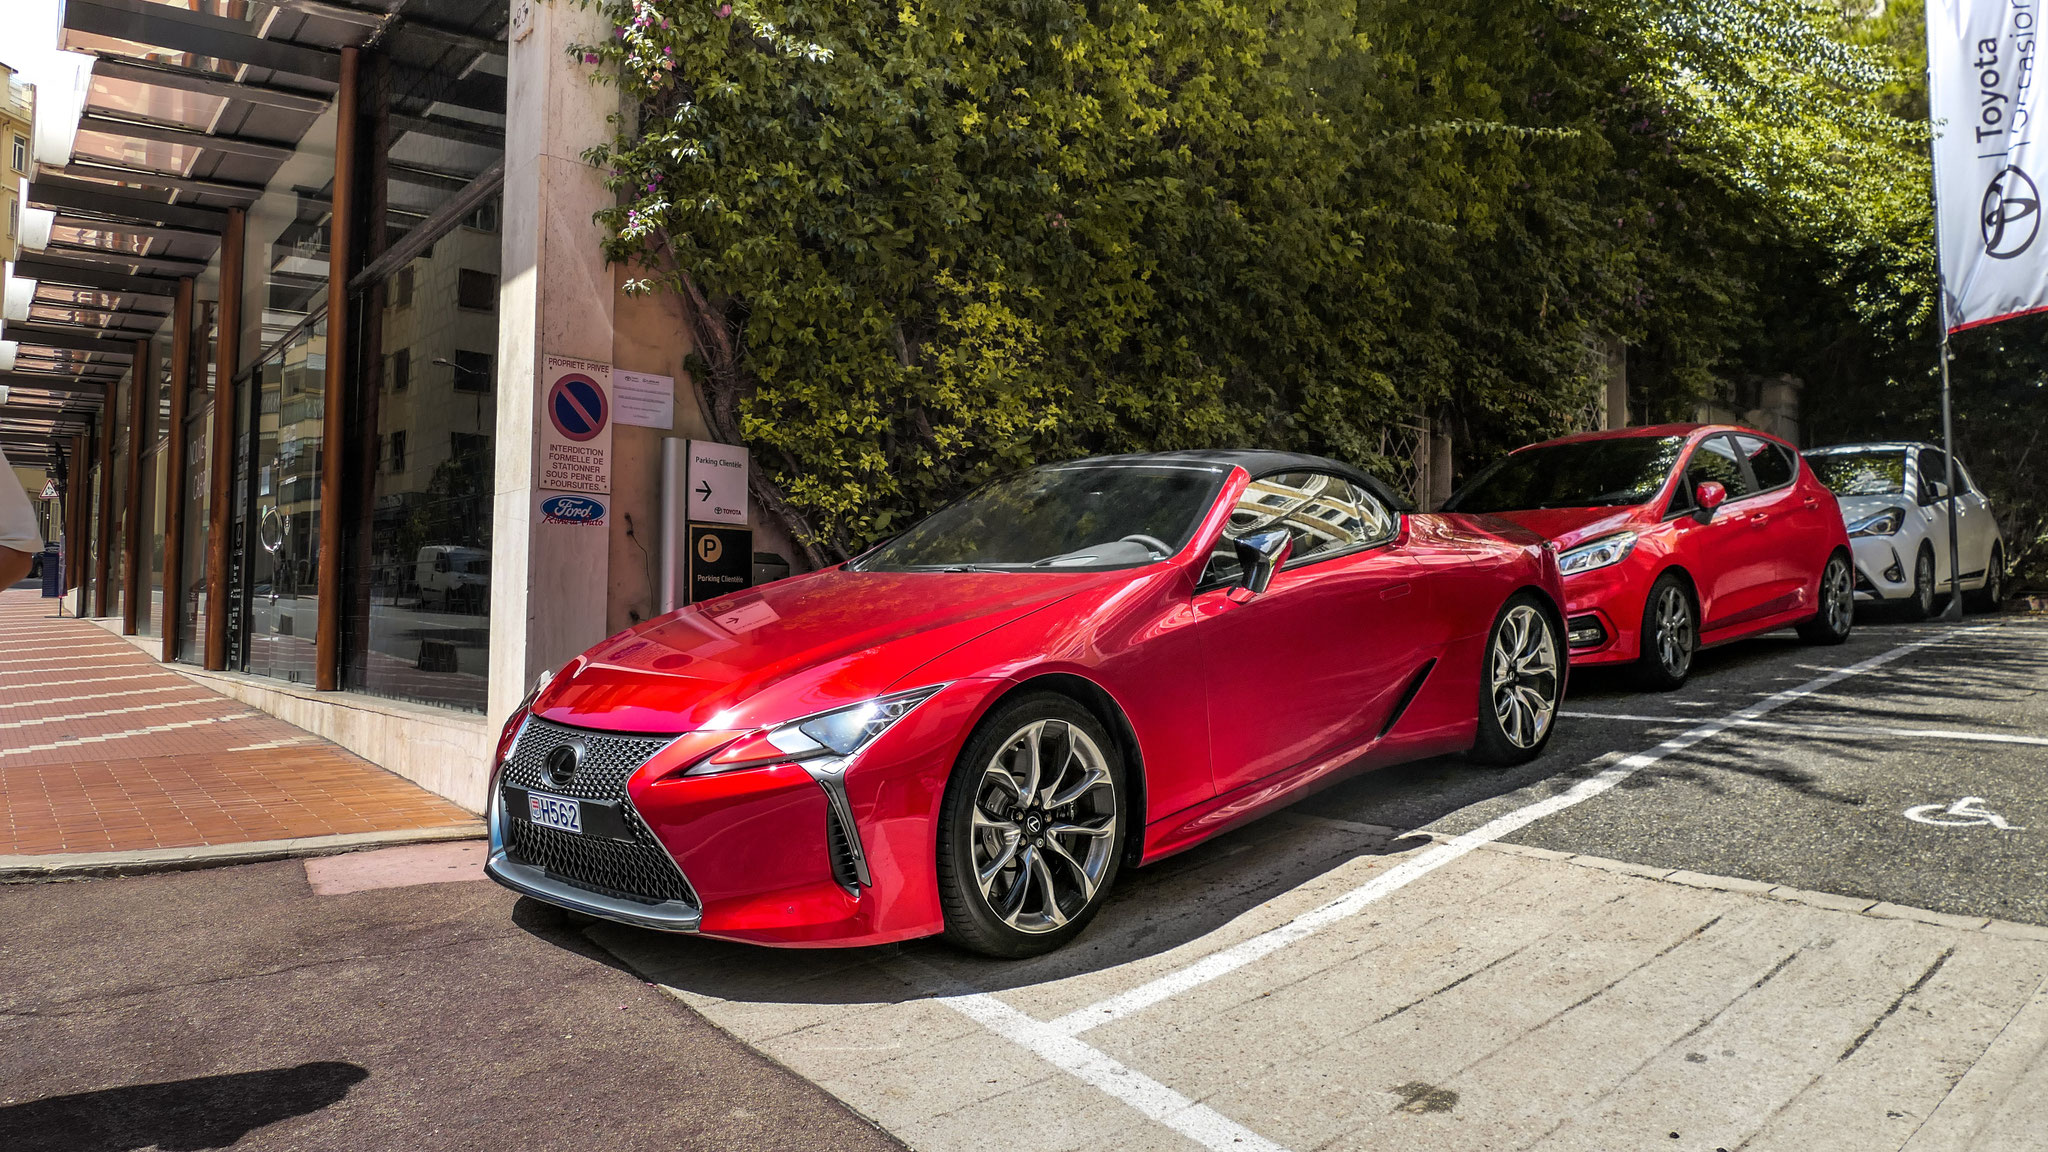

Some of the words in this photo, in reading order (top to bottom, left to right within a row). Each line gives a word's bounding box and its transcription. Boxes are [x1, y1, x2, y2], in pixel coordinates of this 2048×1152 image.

[1974, 38, 2008, 144] Toyota
[548, 357, 585, 370] PROPRIETE
[586, 363, 610, 374] PRIVEE
[549, 443, 604, 457] INTERDICTION
[548, 452, 591, 464] FORMELLE
[593, 457, 604, 466] DE
[695, 456, 718, 467] Parking
[552, 461, 601, 474] STATIONNER
[545, 469, 569, 480] SOUS
[570, 472, 593, 482] PEINE
[595, 475, 606, 483] DE
[550, 479, 601, 491] POURSUITES.
[554, 498, 593, 517] Ford
[723, 508, 742, 516] TOYOTA
[703, 538, 717, 558] P
[697, 574, 720, 584] Parking
[541, 799, 579, 829] H562
